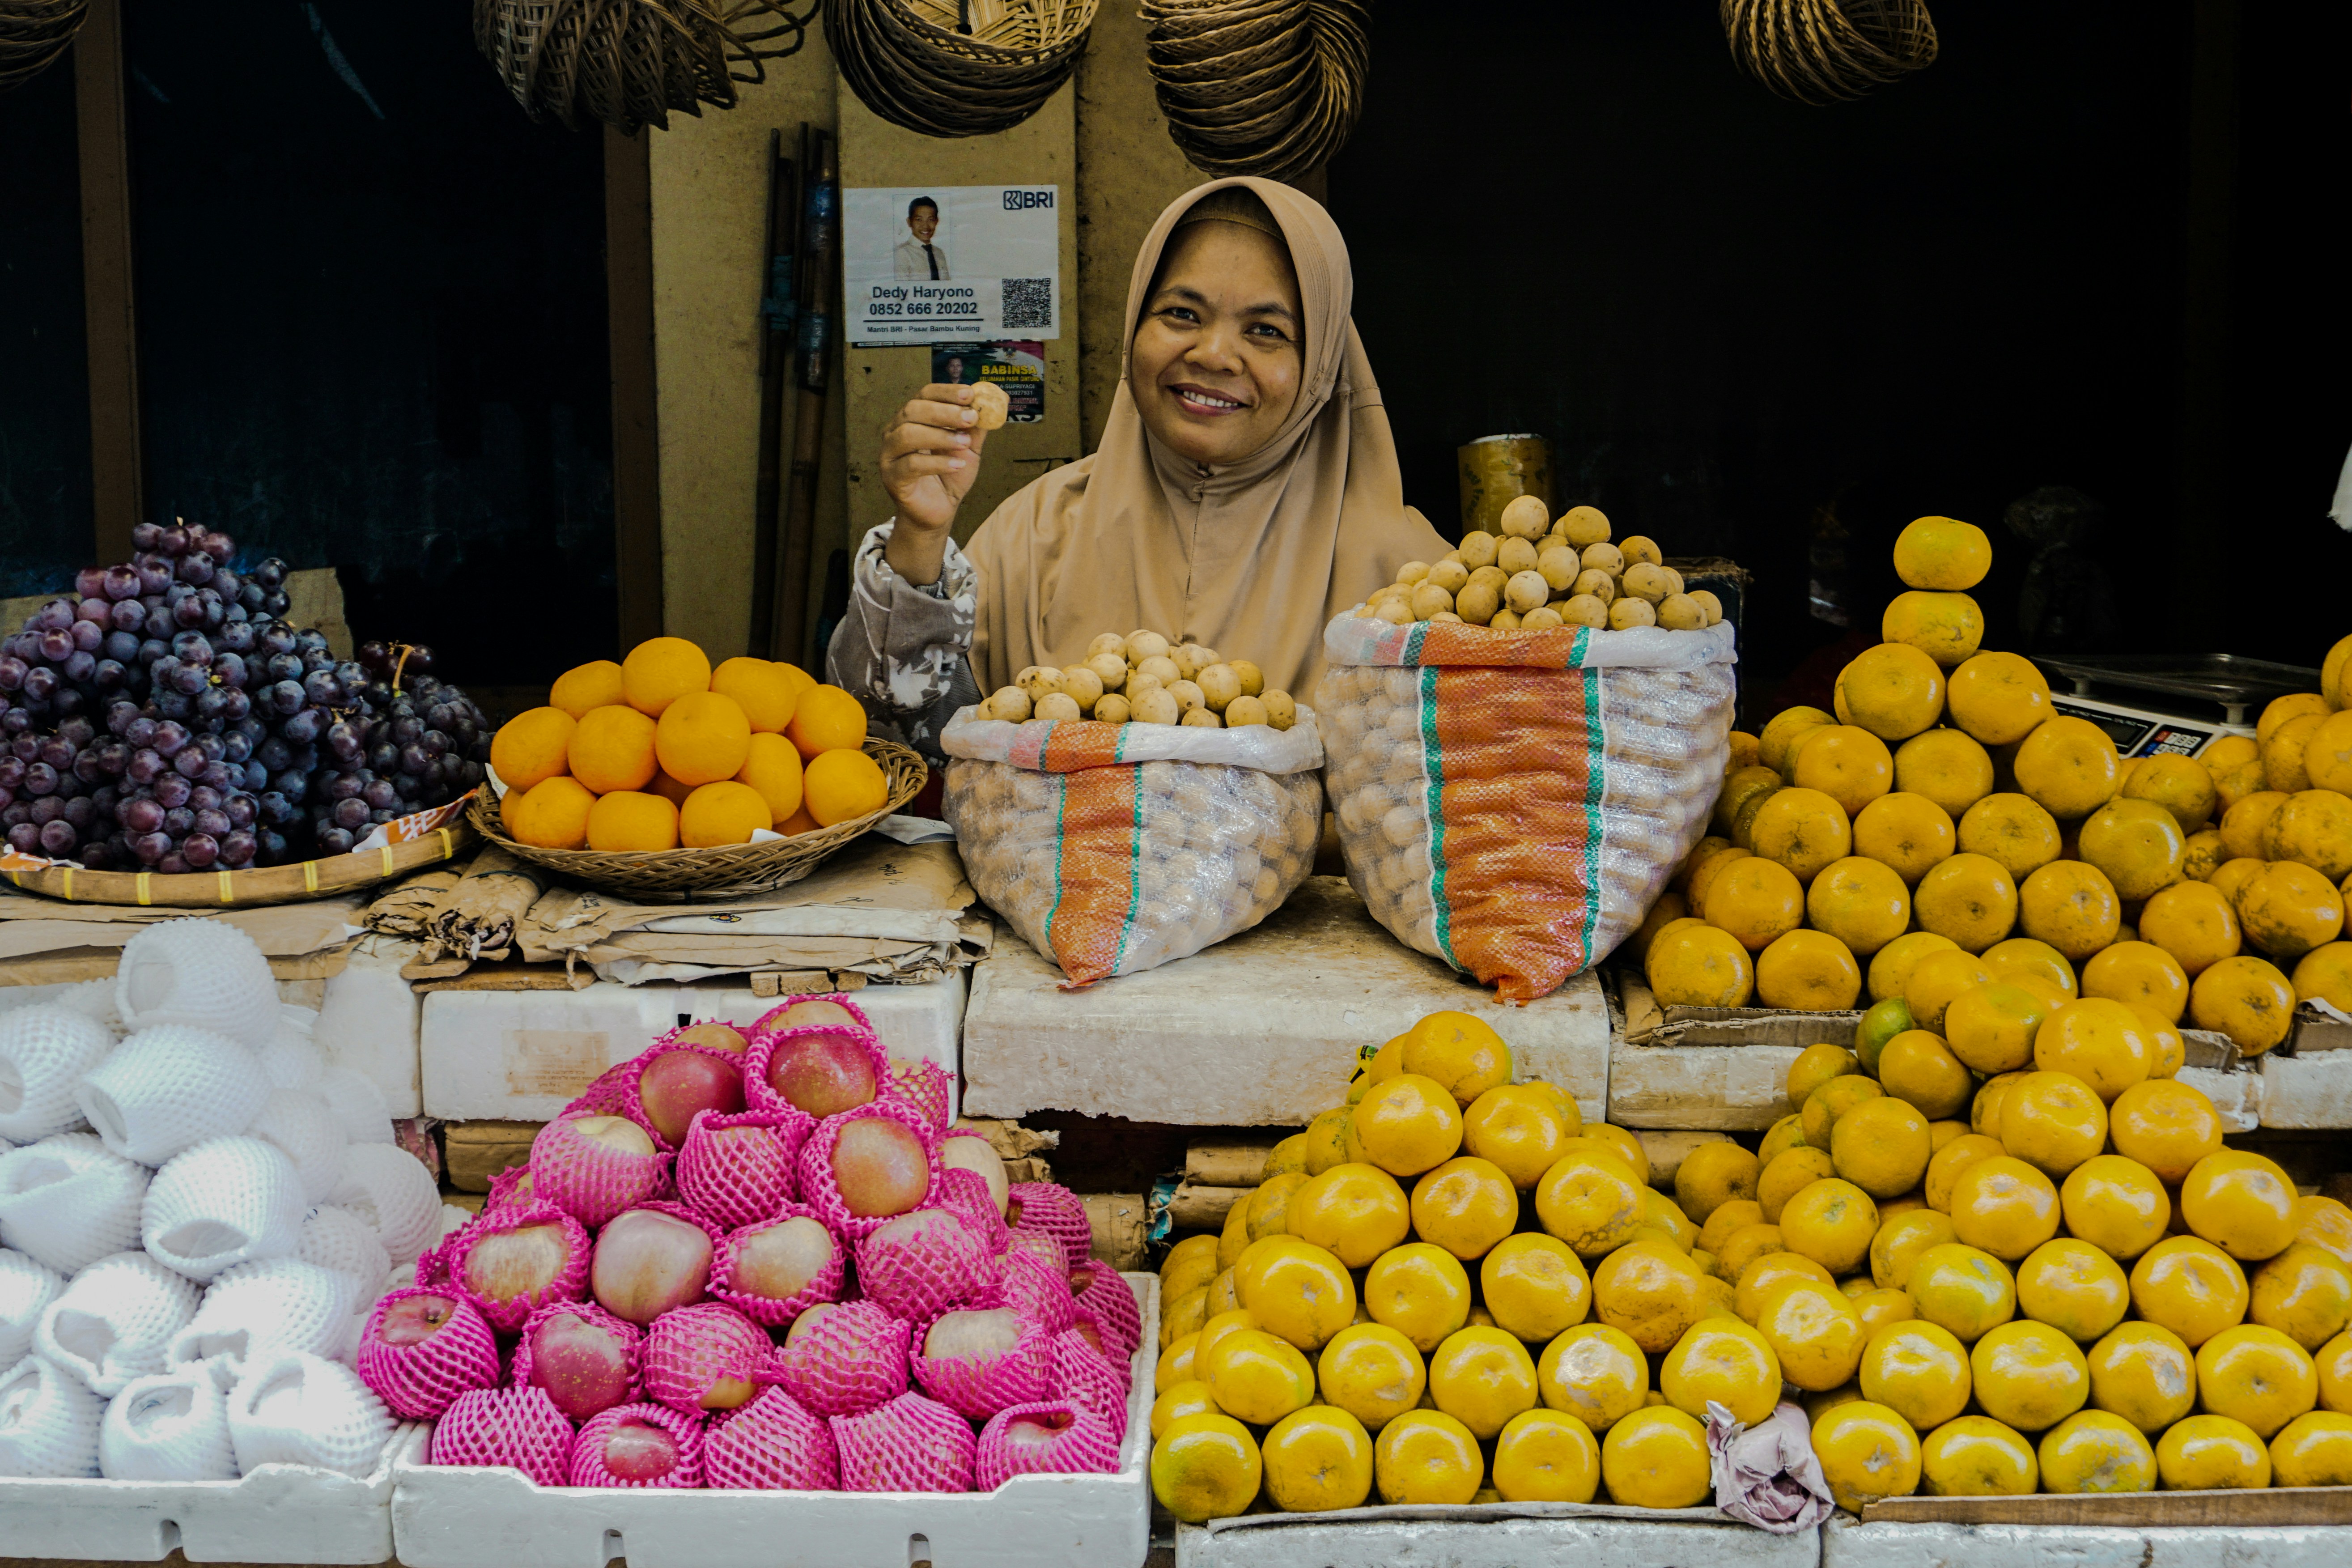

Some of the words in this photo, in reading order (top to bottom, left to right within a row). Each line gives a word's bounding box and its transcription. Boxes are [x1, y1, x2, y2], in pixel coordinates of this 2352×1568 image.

[1023, 191, 1053, 208] BRI
[873, 286, 909, 301] Dedy
[913, 286, 974, 300] Haryono
[869, 303, 902, 315] 0852
[907, 302, 931, 314] 666
[936, 302, 977, 314] 20202
[982, 365, 1037, 374] BABINSA
